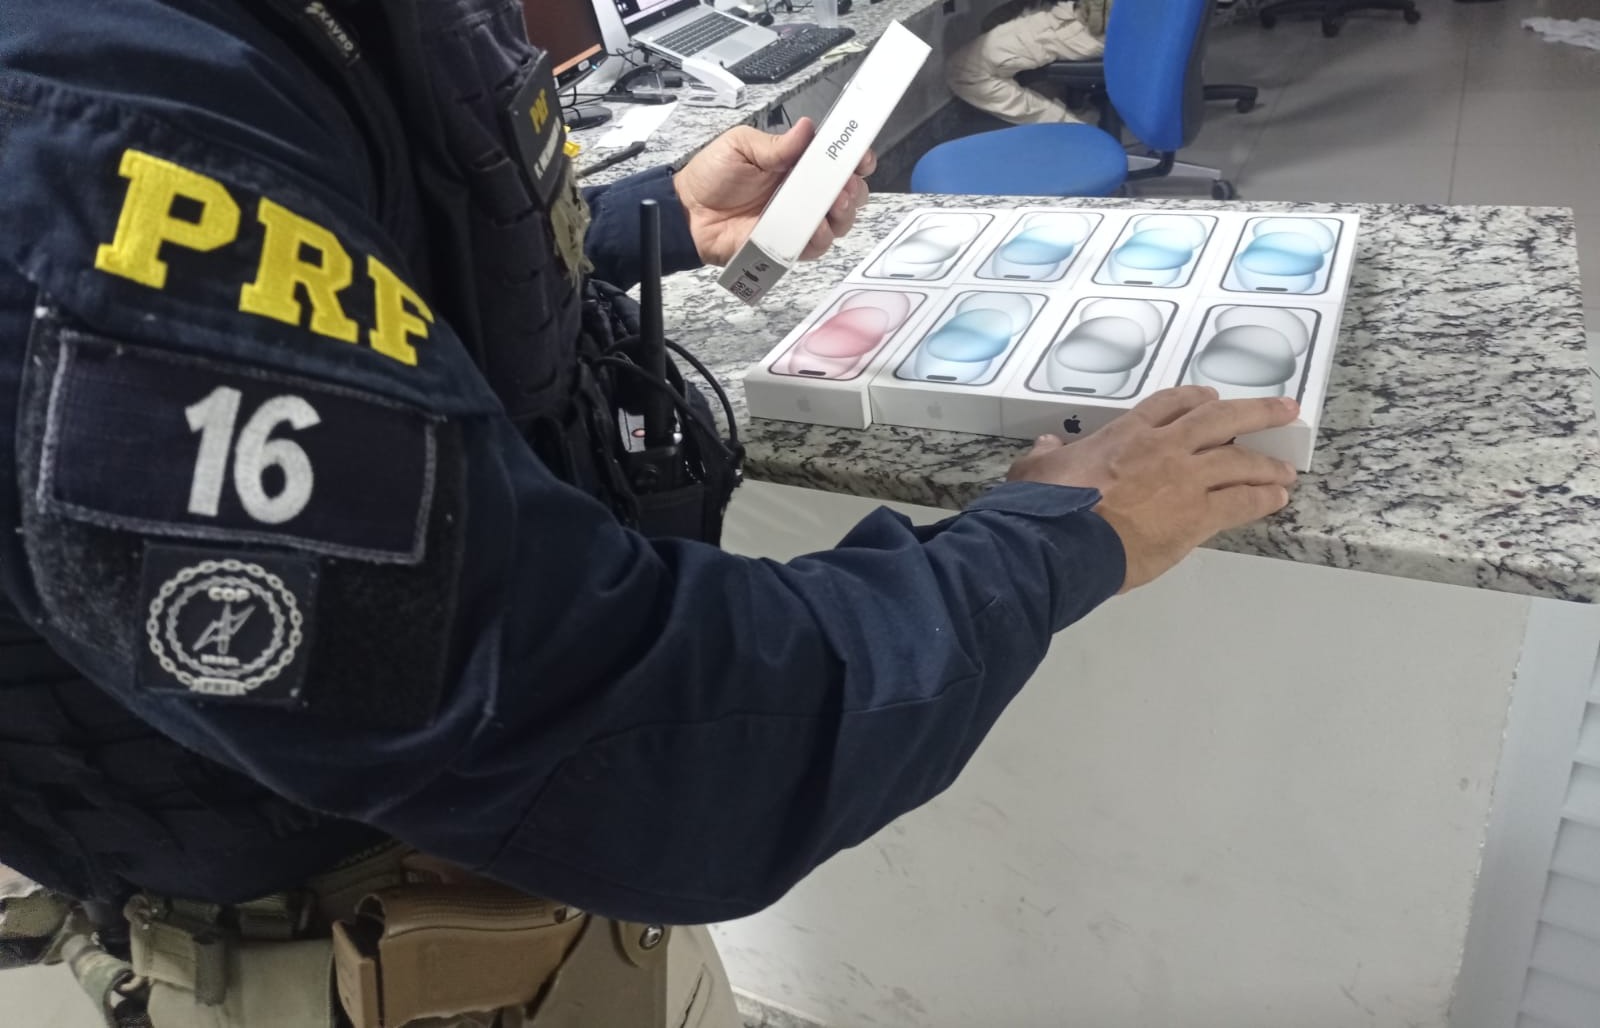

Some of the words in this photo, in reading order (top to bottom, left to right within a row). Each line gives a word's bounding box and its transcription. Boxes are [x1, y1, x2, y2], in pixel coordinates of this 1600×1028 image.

[825, 119, 858, 160] iPhone
[94, 149, 434, 366] PRF
[184, 386, 321, 523] 16
